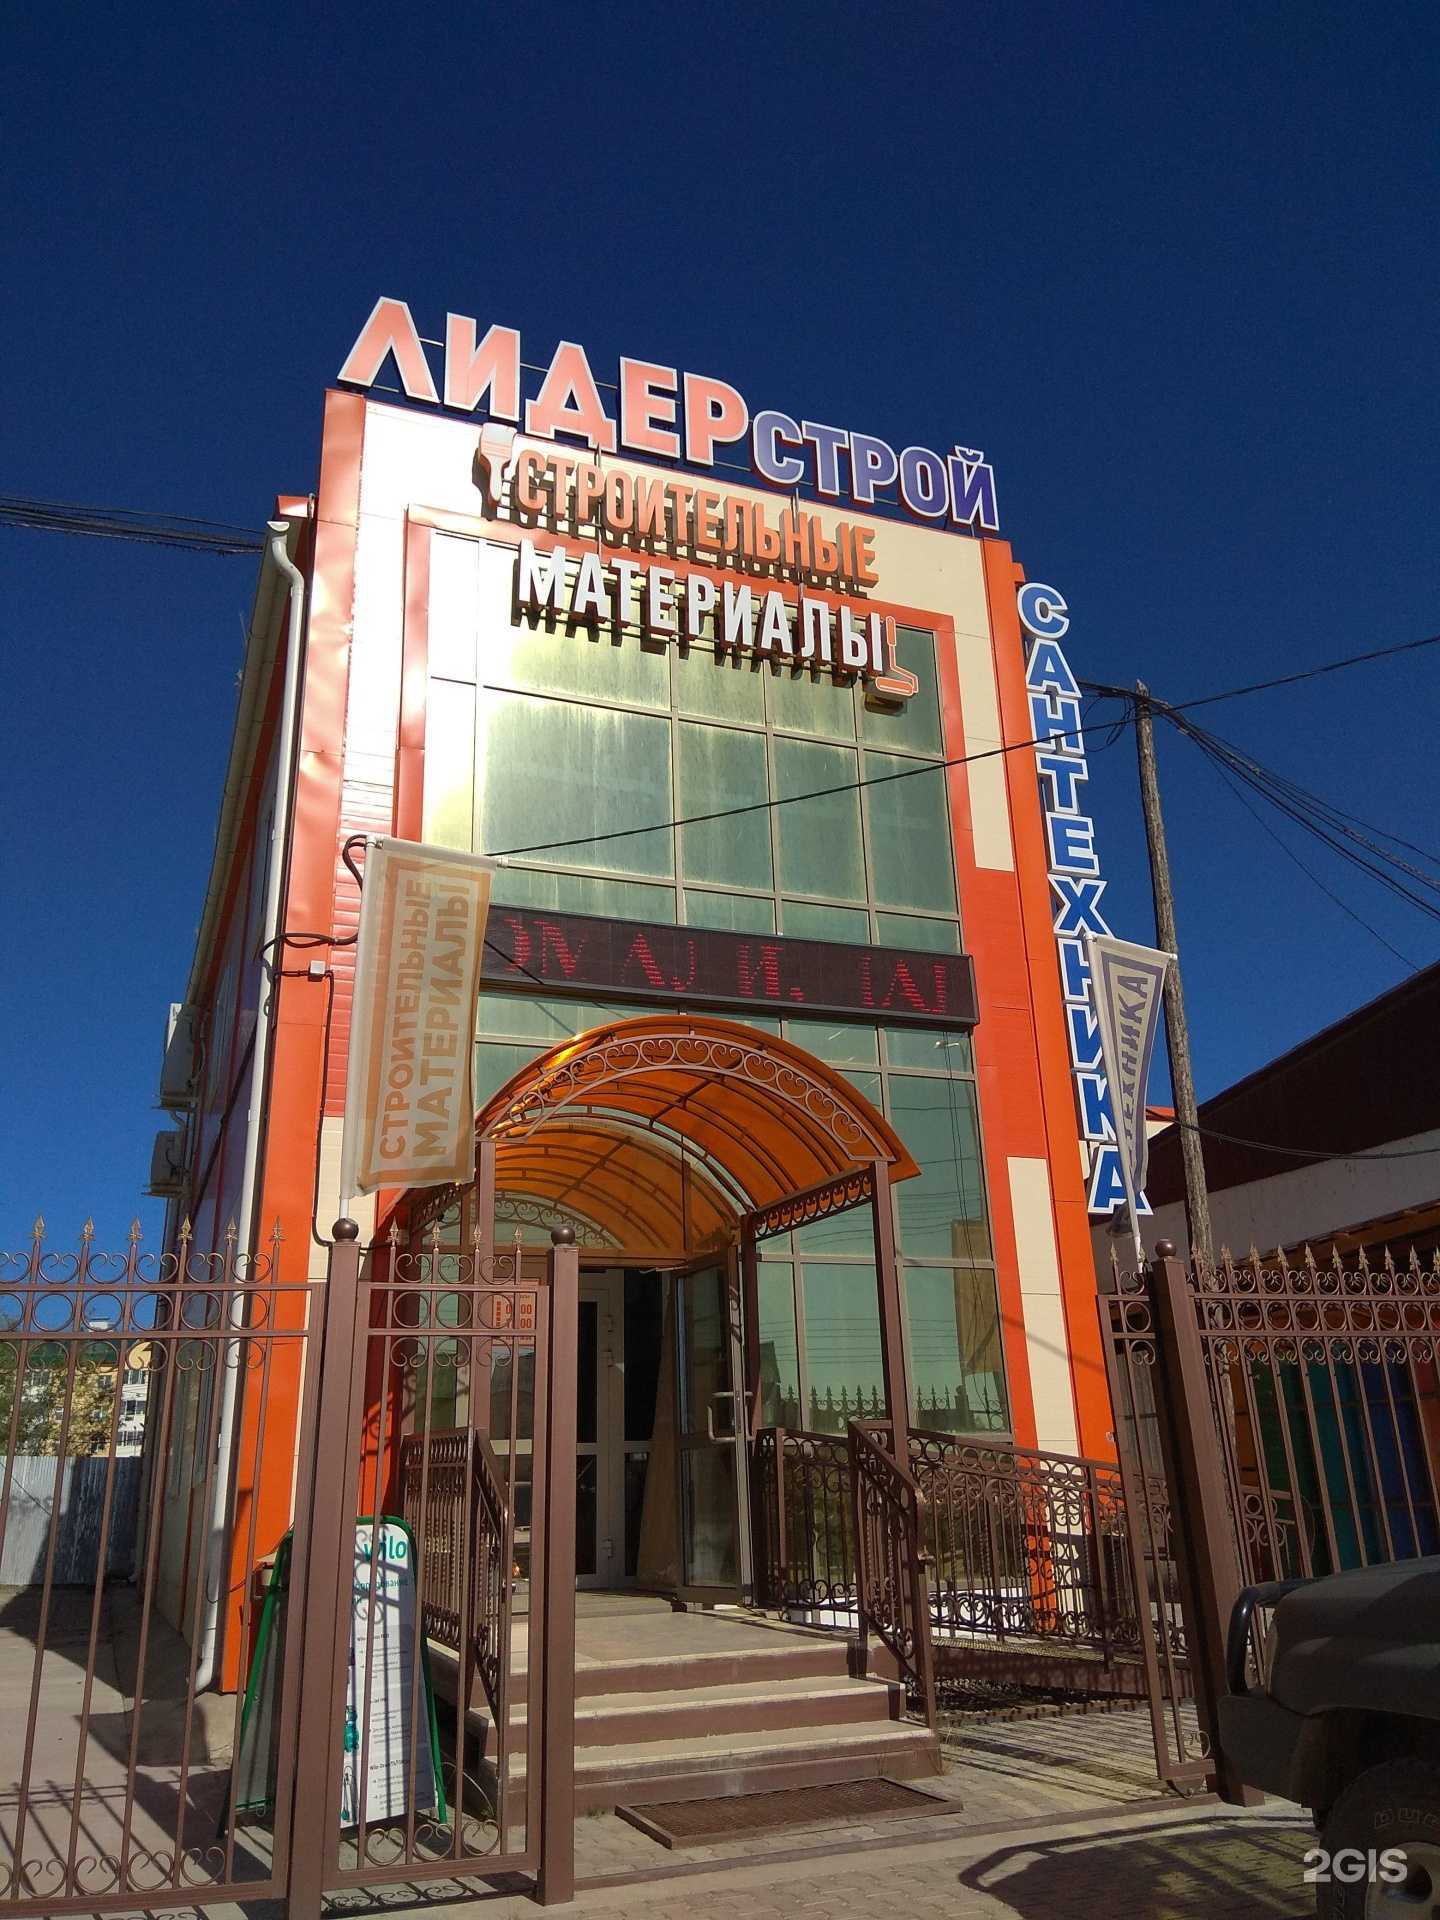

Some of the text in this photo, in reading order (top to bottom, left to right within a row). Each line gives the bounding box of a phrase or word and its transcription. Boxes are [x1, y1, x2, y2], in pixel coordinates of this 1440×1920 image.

[516, 447, 880, 588] СТРОИТЕЛЬНЫЕ
[518, 538, 884, 674] МАТЕРИАЛЫ
[379, 877, 435, 1161] СТРОИТЕЛЬНЫЕ
[412, 883, 471, 1160] МАТЕРИАЛЫ
